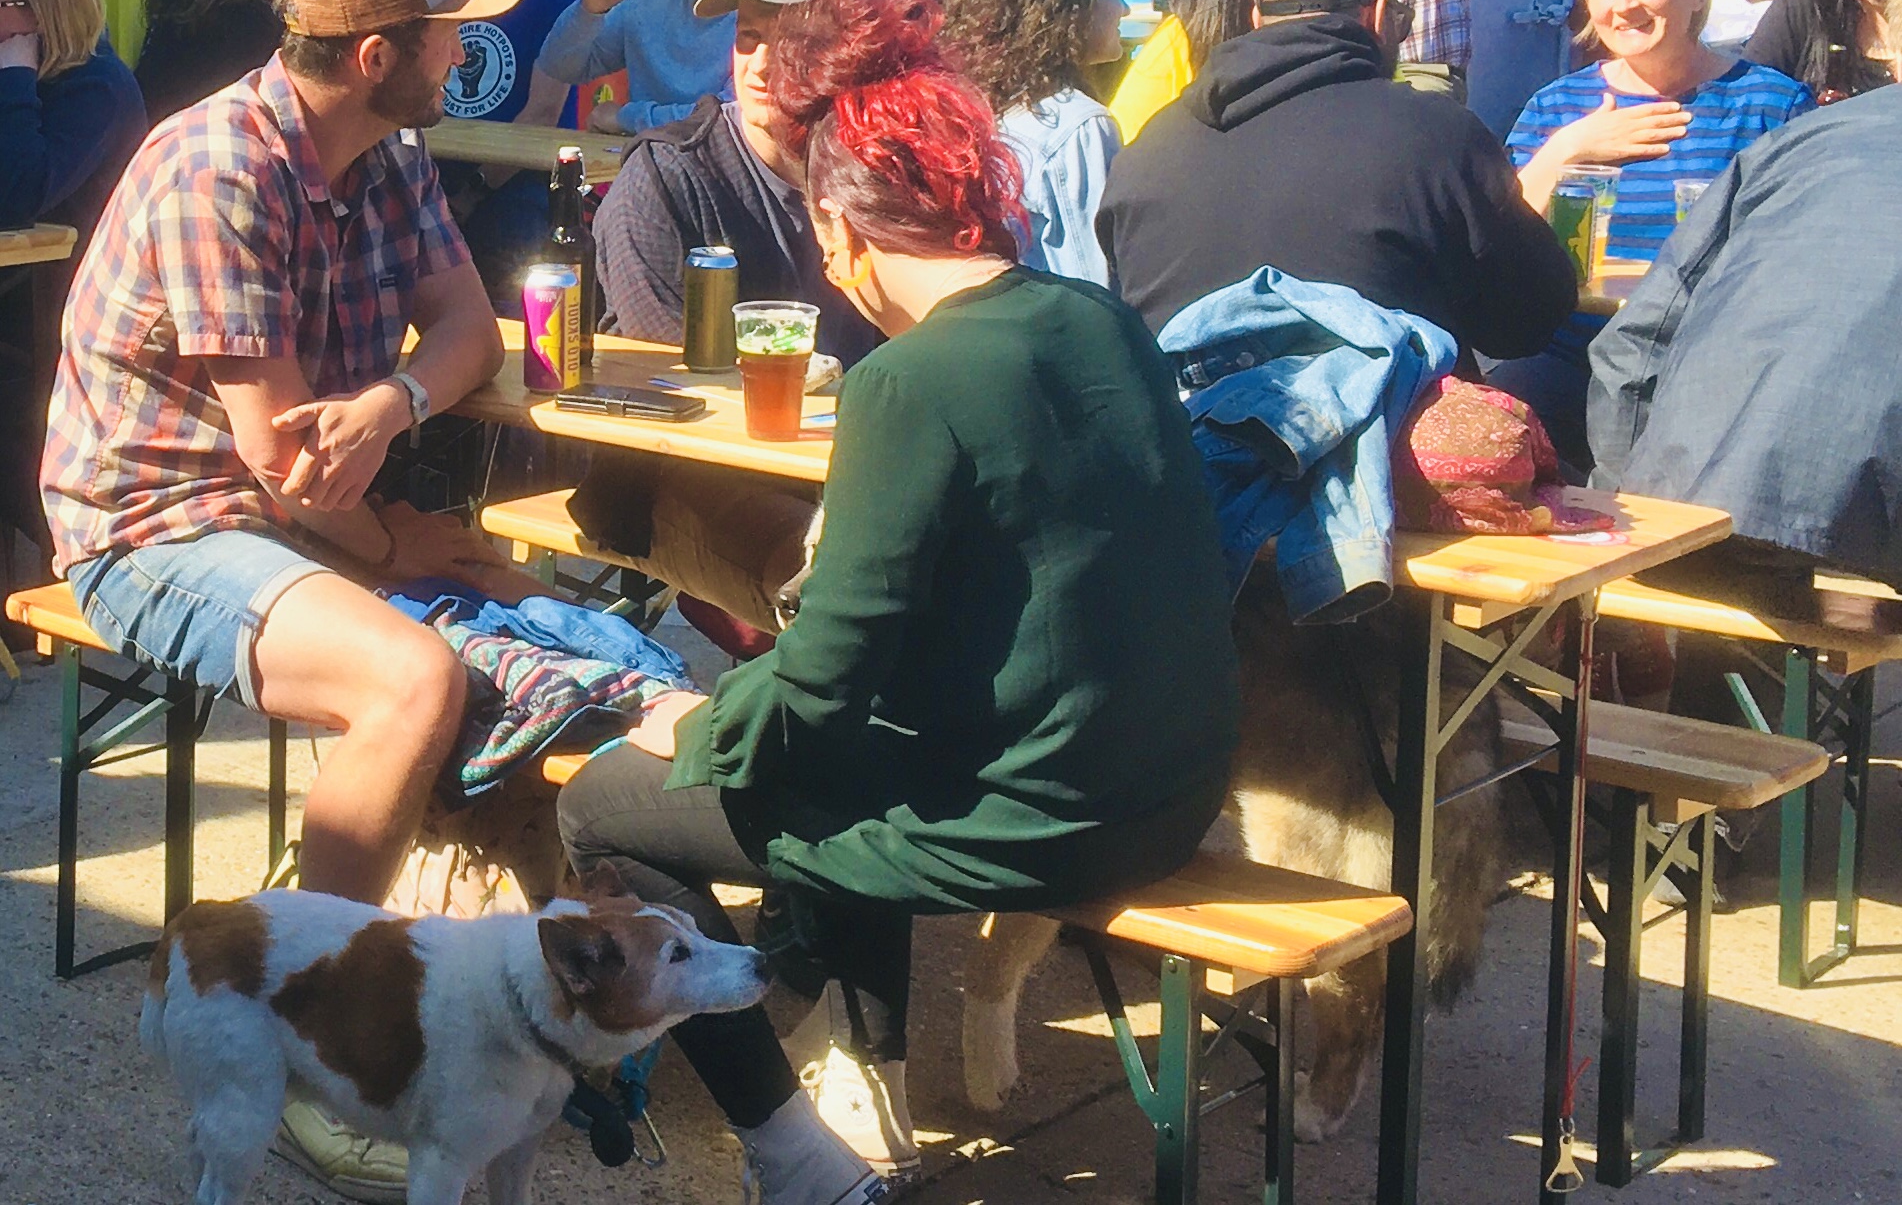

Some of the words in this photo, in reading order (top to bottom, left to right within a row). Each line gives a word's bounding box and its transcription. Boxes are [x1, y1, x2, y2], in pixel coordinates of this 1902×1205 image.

[484, 26, 513, 68] HOTPOTS
[464, 104, 486, 114] FOR
[487, 85, 508, 107] LIFE
[568, 302, 579, 343] SKOOL
[567, 346, 579, 371] OLD
